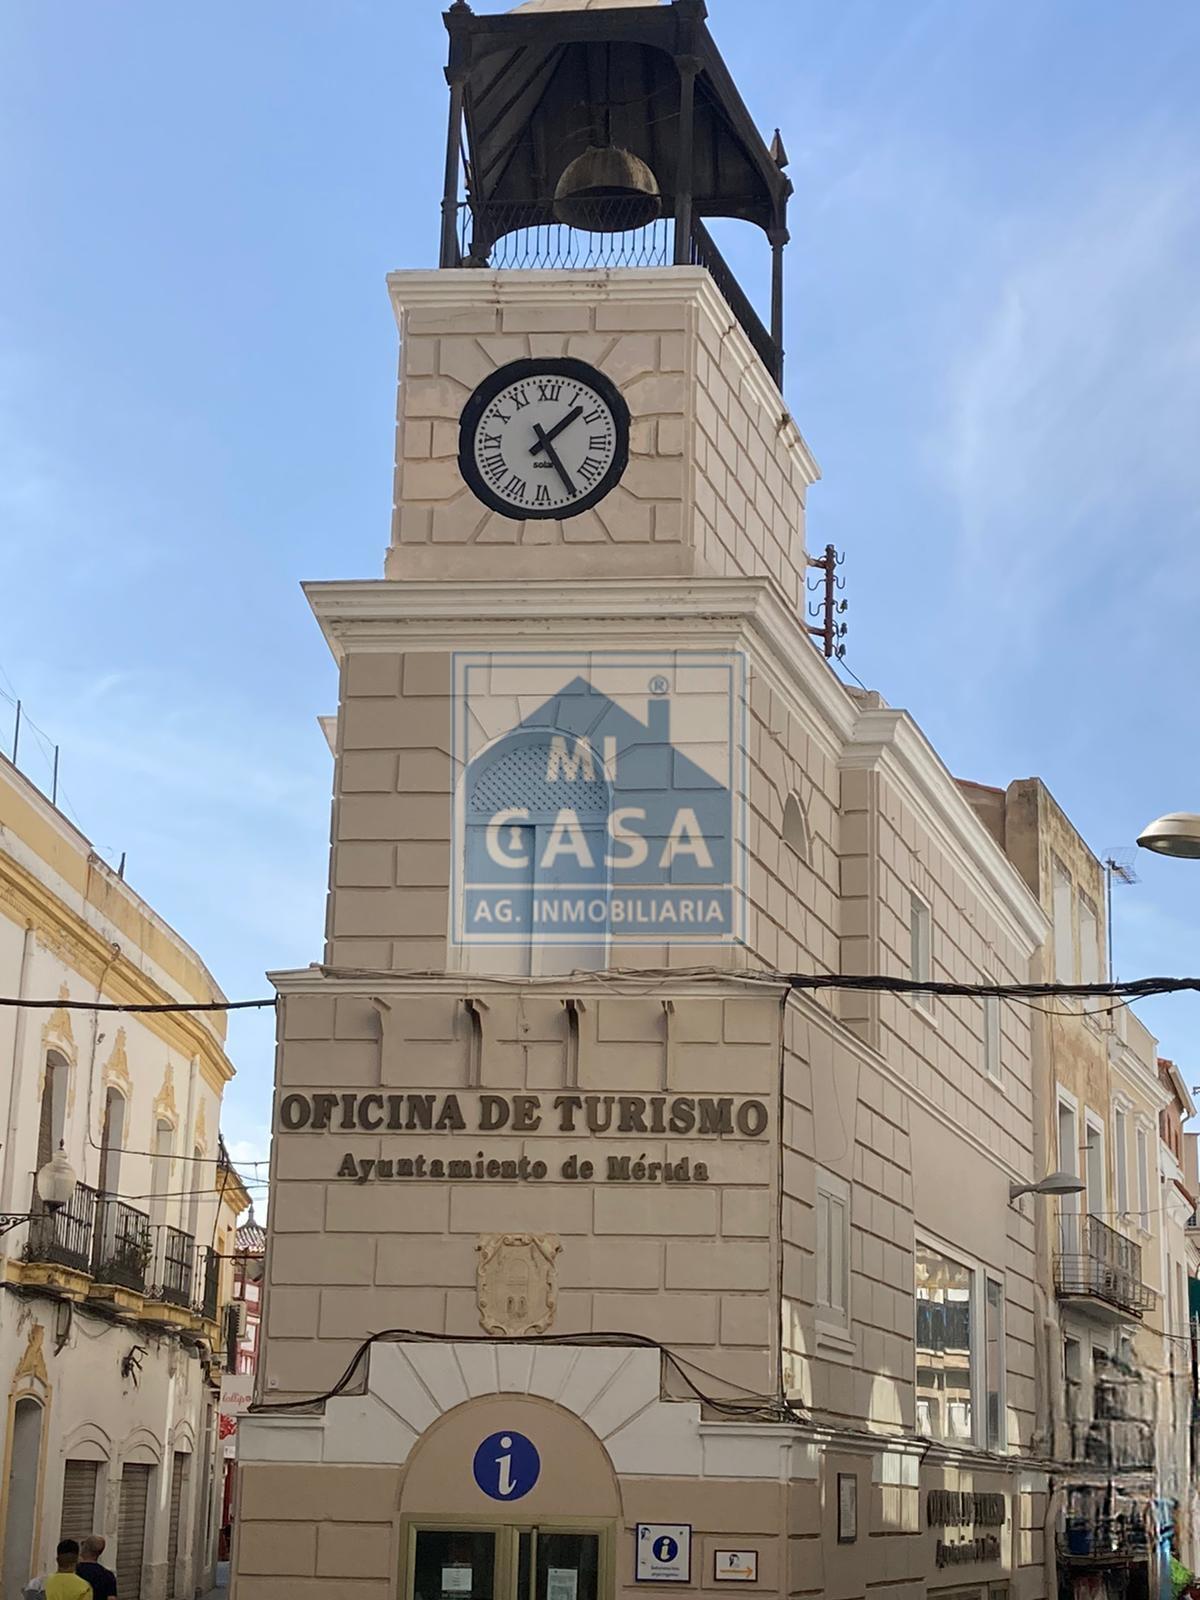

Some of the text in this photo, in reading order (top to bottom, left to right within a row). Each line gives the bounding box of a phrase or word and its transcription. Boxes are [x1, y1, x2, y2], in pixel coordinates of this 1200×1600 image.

[510, 389, 530, 411] XI
[538, 384, 562, 402] XII
[568, 391, 580, 407] I
[492, 409, 511, 425] X
[583, 409, 602, 425] II
[484, 433, 502, 450] IX
[589, 434, 607, 451] III
[503, 474, 526, 498] VII
[534, 484, 551, 501] VI
[280, 1093, 769, 1137] OFICINA DE TURISMO
[337, 1151, 709, 1185] Ayuntamiento de Mérida
